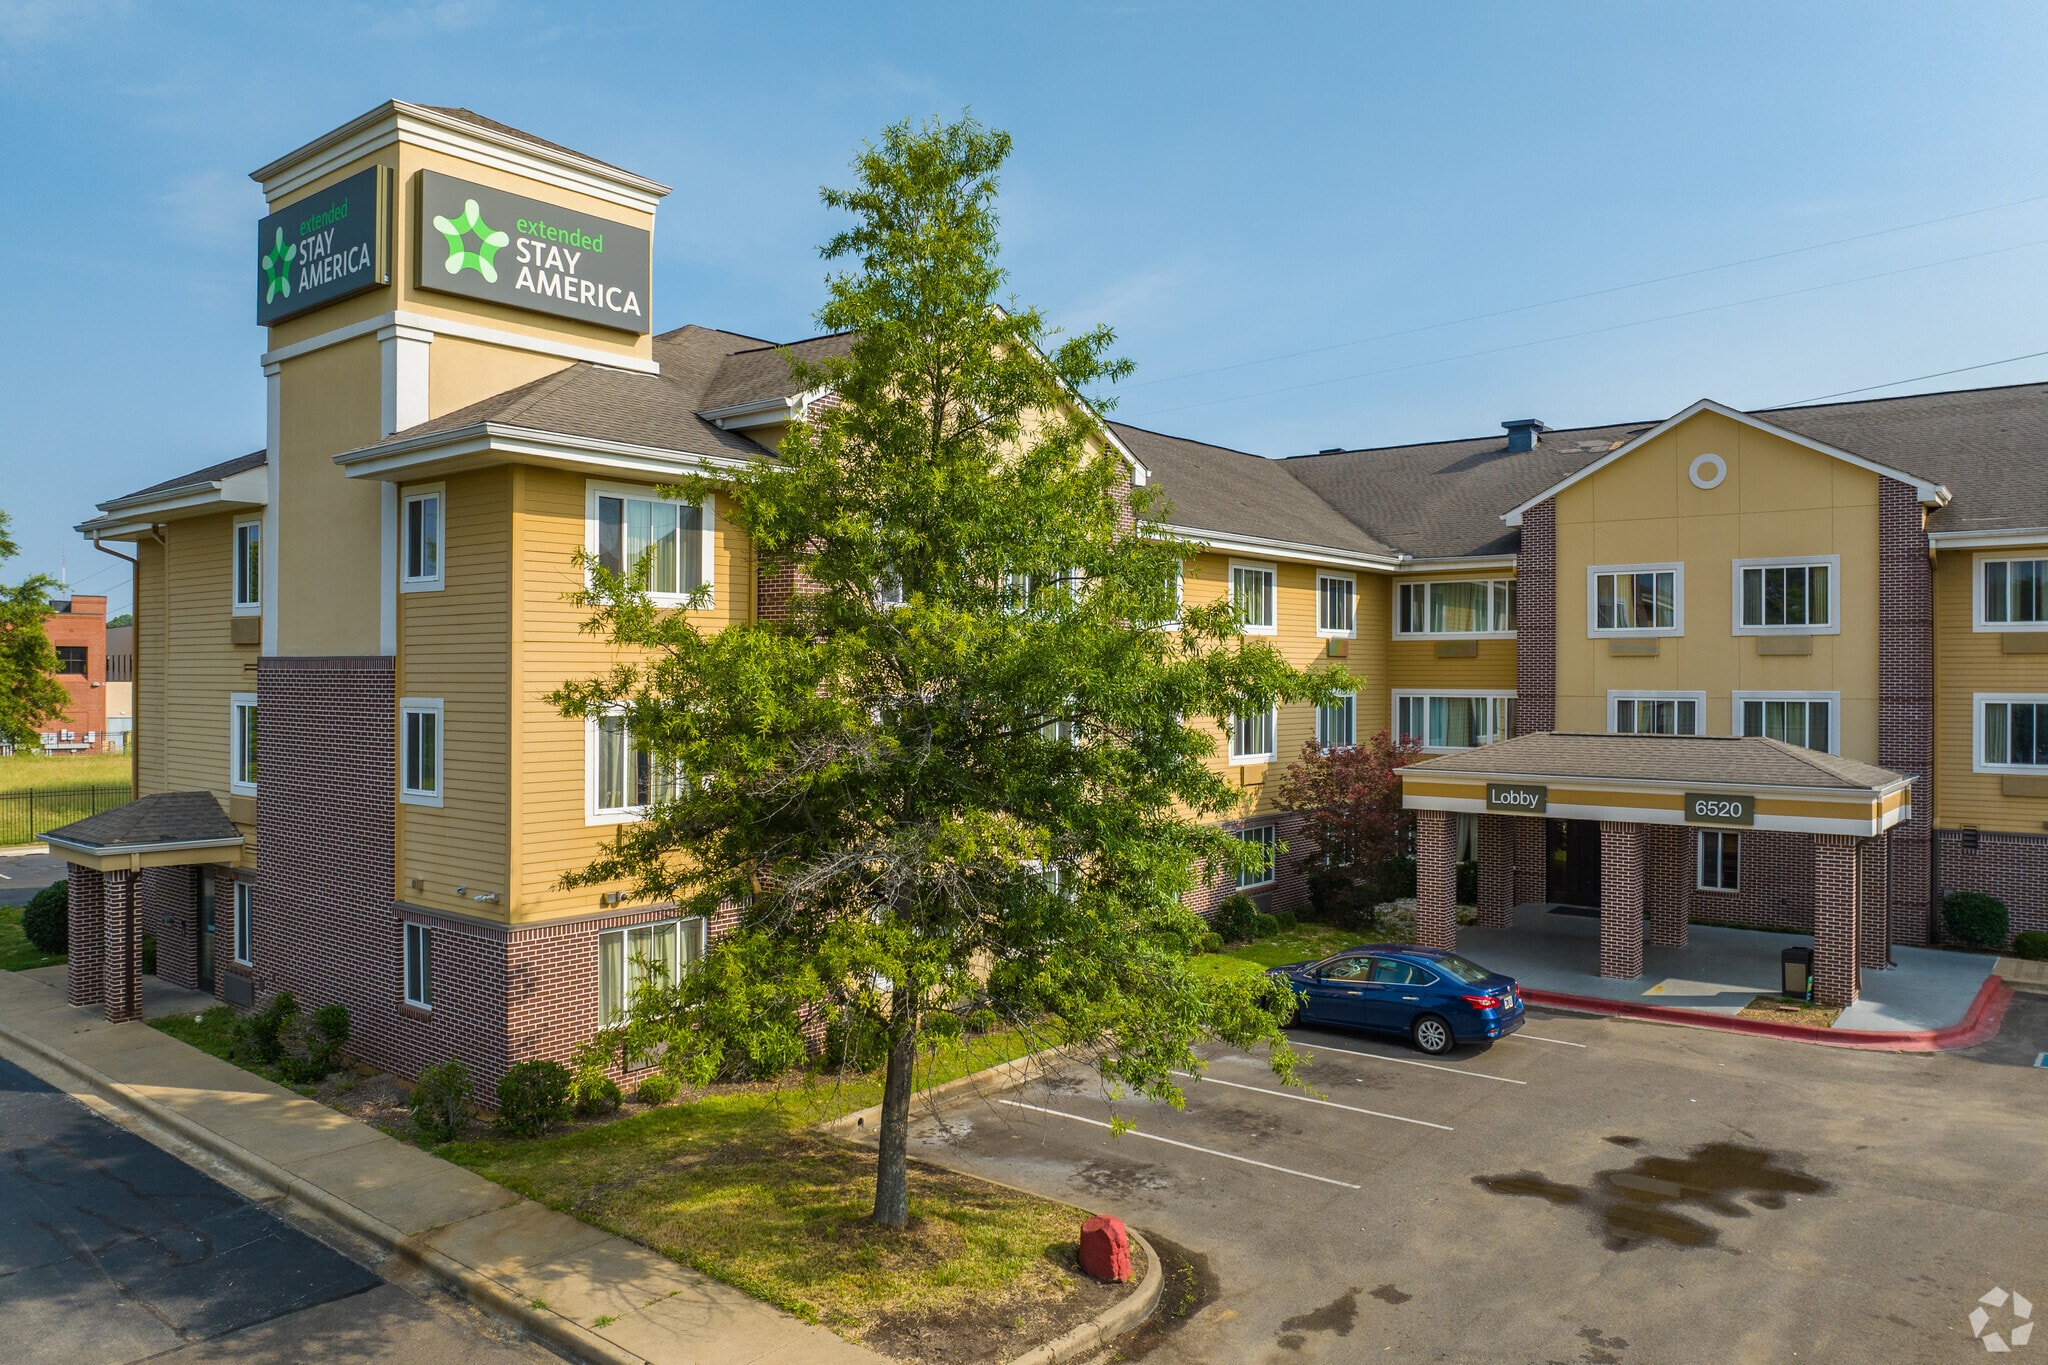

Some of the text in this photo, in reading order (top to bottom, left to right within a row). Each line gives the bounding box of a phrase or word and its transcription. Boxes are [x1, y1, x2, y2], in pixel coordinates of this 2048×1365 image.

[299, 196, 348, 236] extended
[299, 227, 335, 266] STAY
[516, 218, 603, 253] extended
[298, 242, 371, 293] AMERICA
[516, 237, 581, 275] STAY
[515, 266, 642, 317] AMERICA
[1491, 788, 1539, 809] Lobby
[1695, 800, 1743, 818] 6520
